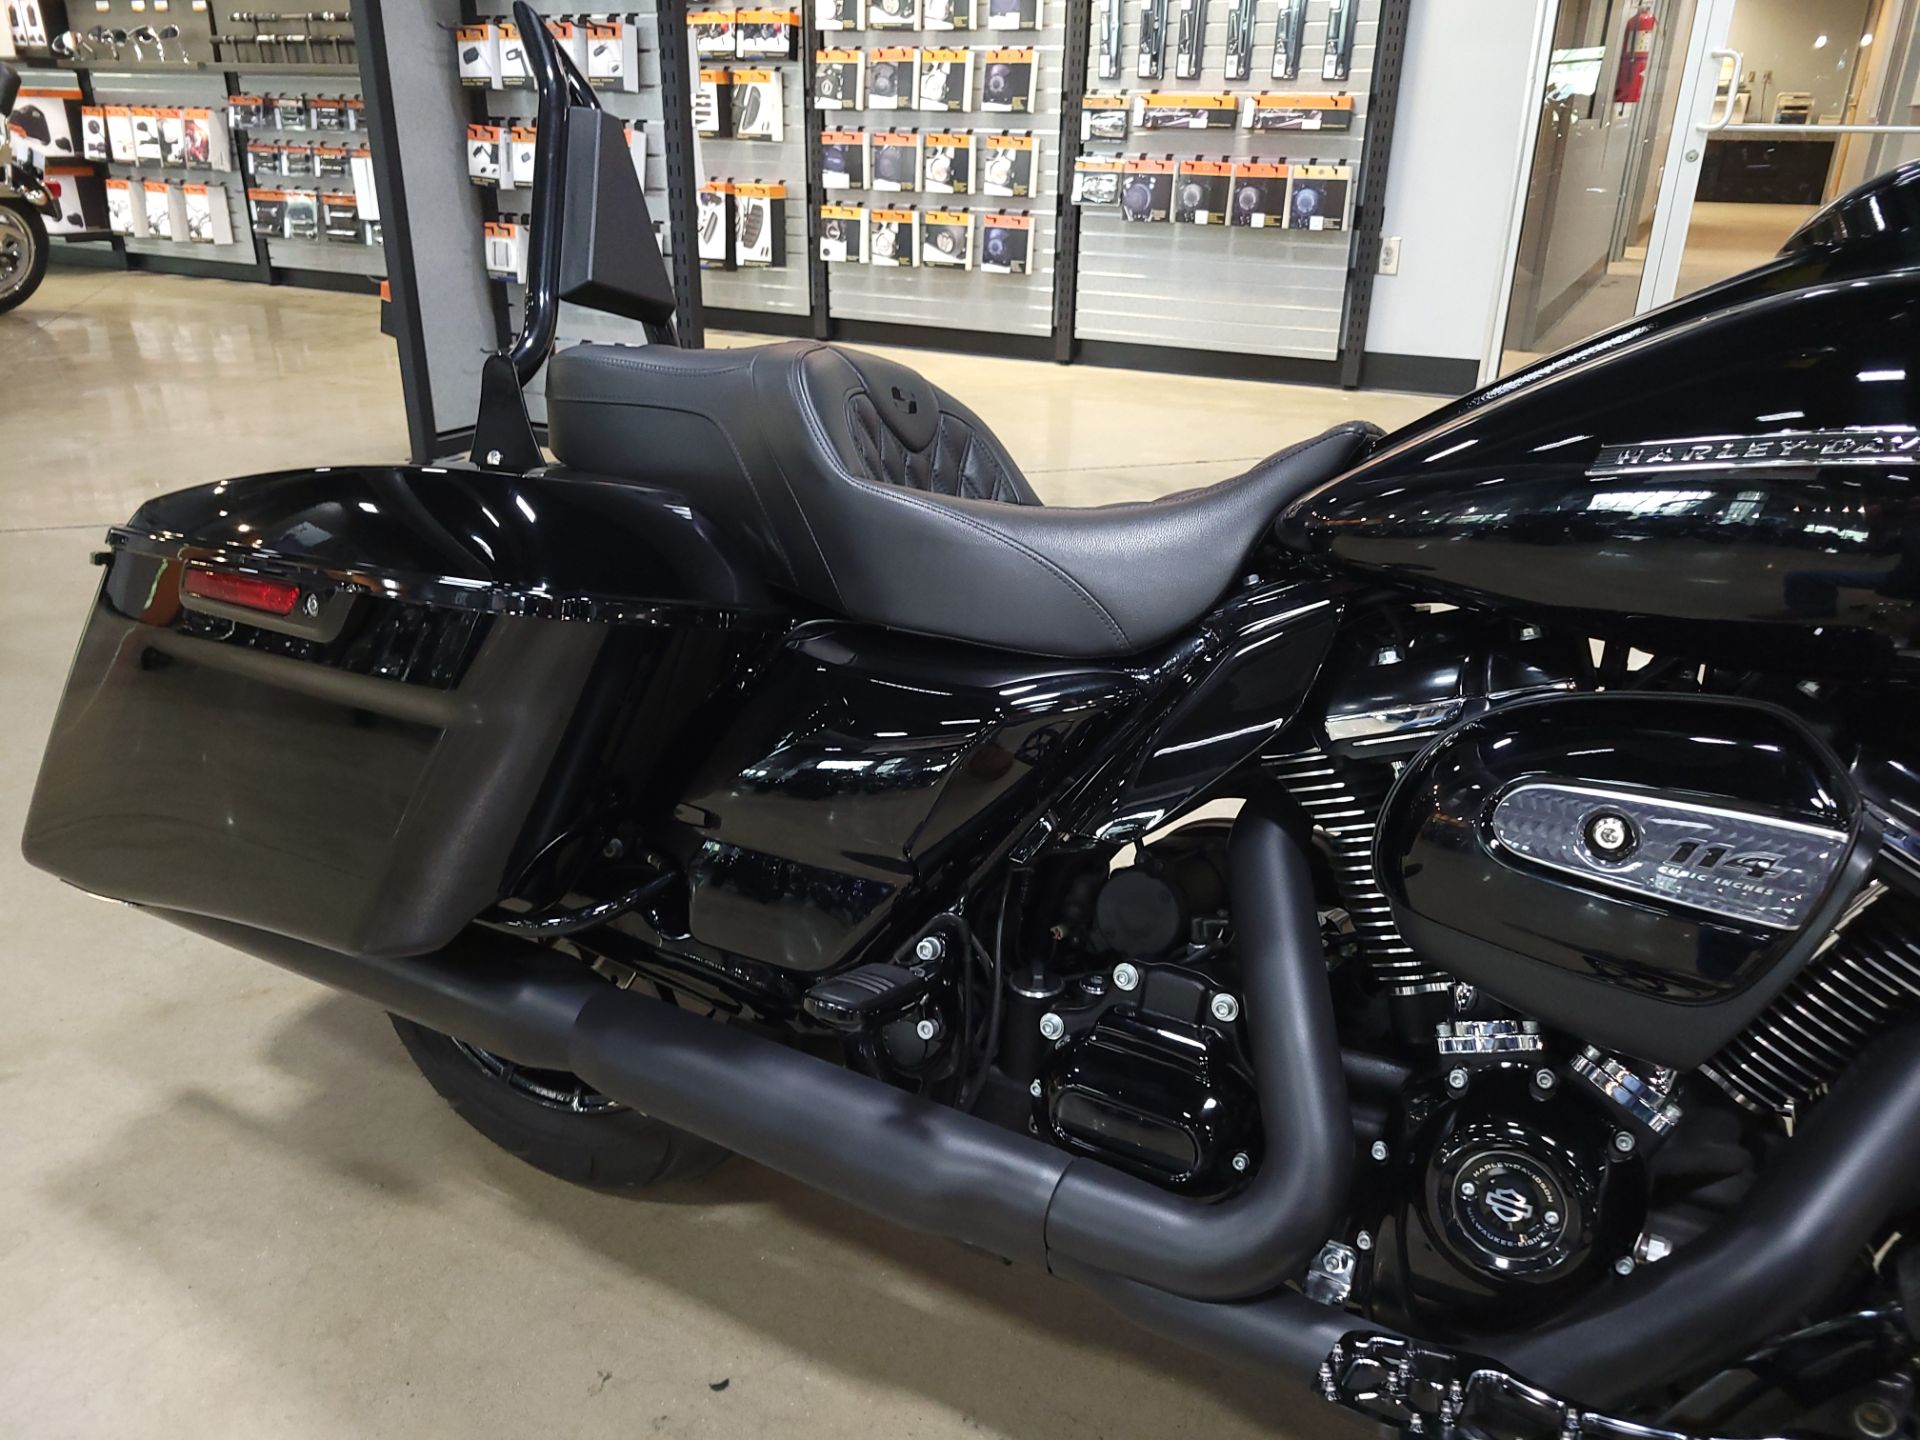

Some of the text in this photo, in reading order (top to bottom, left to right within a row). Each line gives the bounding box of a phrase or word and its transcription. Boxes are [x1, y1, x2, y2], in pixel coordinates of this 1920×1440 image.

[1615, 436, 1920, 465] HARLEY-DAV
[1662, 837, 1790, 881] 114
[1657, 865, 1776, 896] CUBIC INCHES
